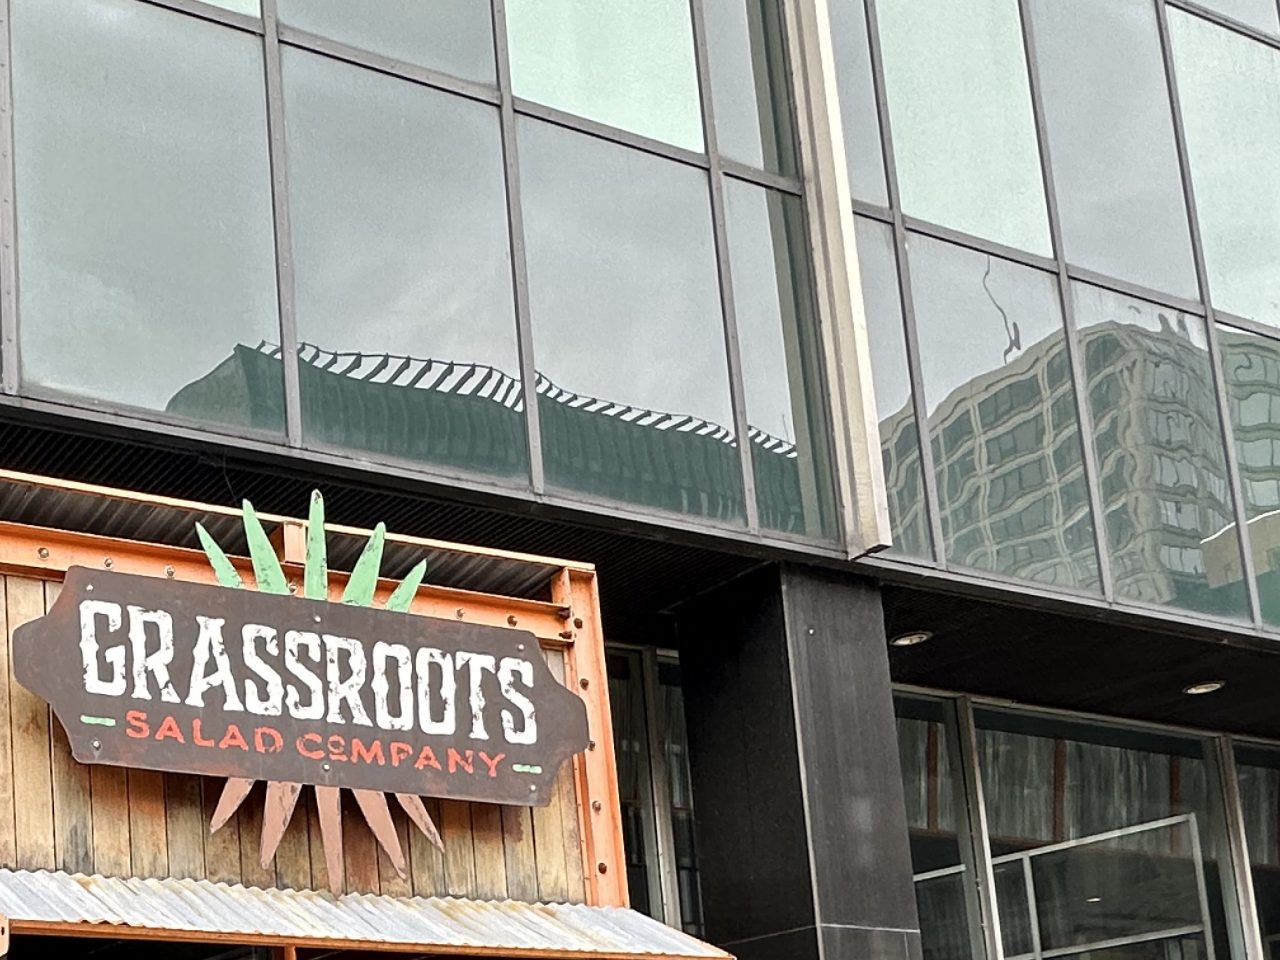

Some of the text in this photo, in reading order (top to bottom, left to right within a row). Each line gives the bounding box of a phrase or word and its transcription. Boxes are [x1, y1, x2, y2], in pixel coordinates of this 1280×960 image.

[78, 599, 538, 746] GRASSROOTS
[125, 709, 506, 778] SALAD COMPANY
